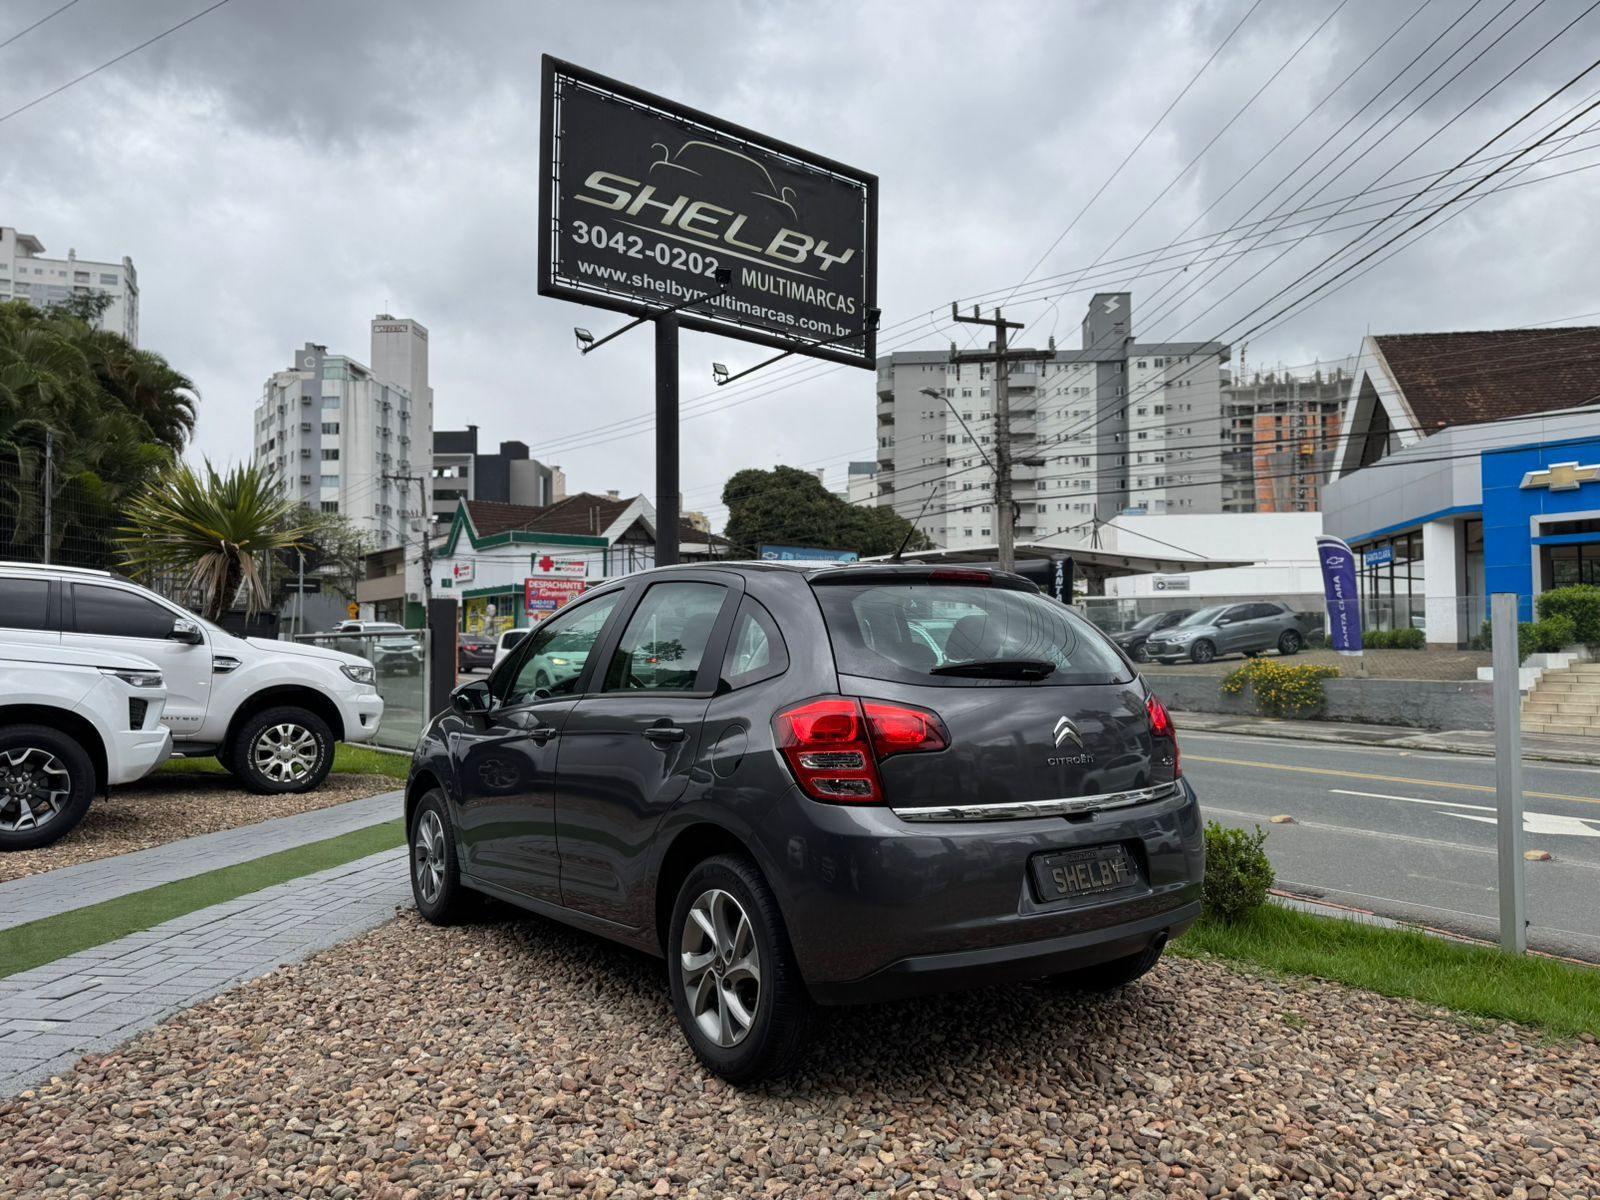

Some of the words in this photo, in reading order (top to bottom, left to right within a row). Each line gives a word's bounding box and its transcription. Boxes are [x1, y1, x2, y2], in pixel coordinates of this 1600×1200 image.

[573, 171, 855, 272] SHELBY
[572, 220, 719, 278] 3042-0202
[741, 267, 856, 315] MULTIMARCAS
[528, 581, 583, 590] DESPACHANTE
[1055, 560, 1064, 602] SANTA
[1052, 858, 1121, 894] SHELBY
